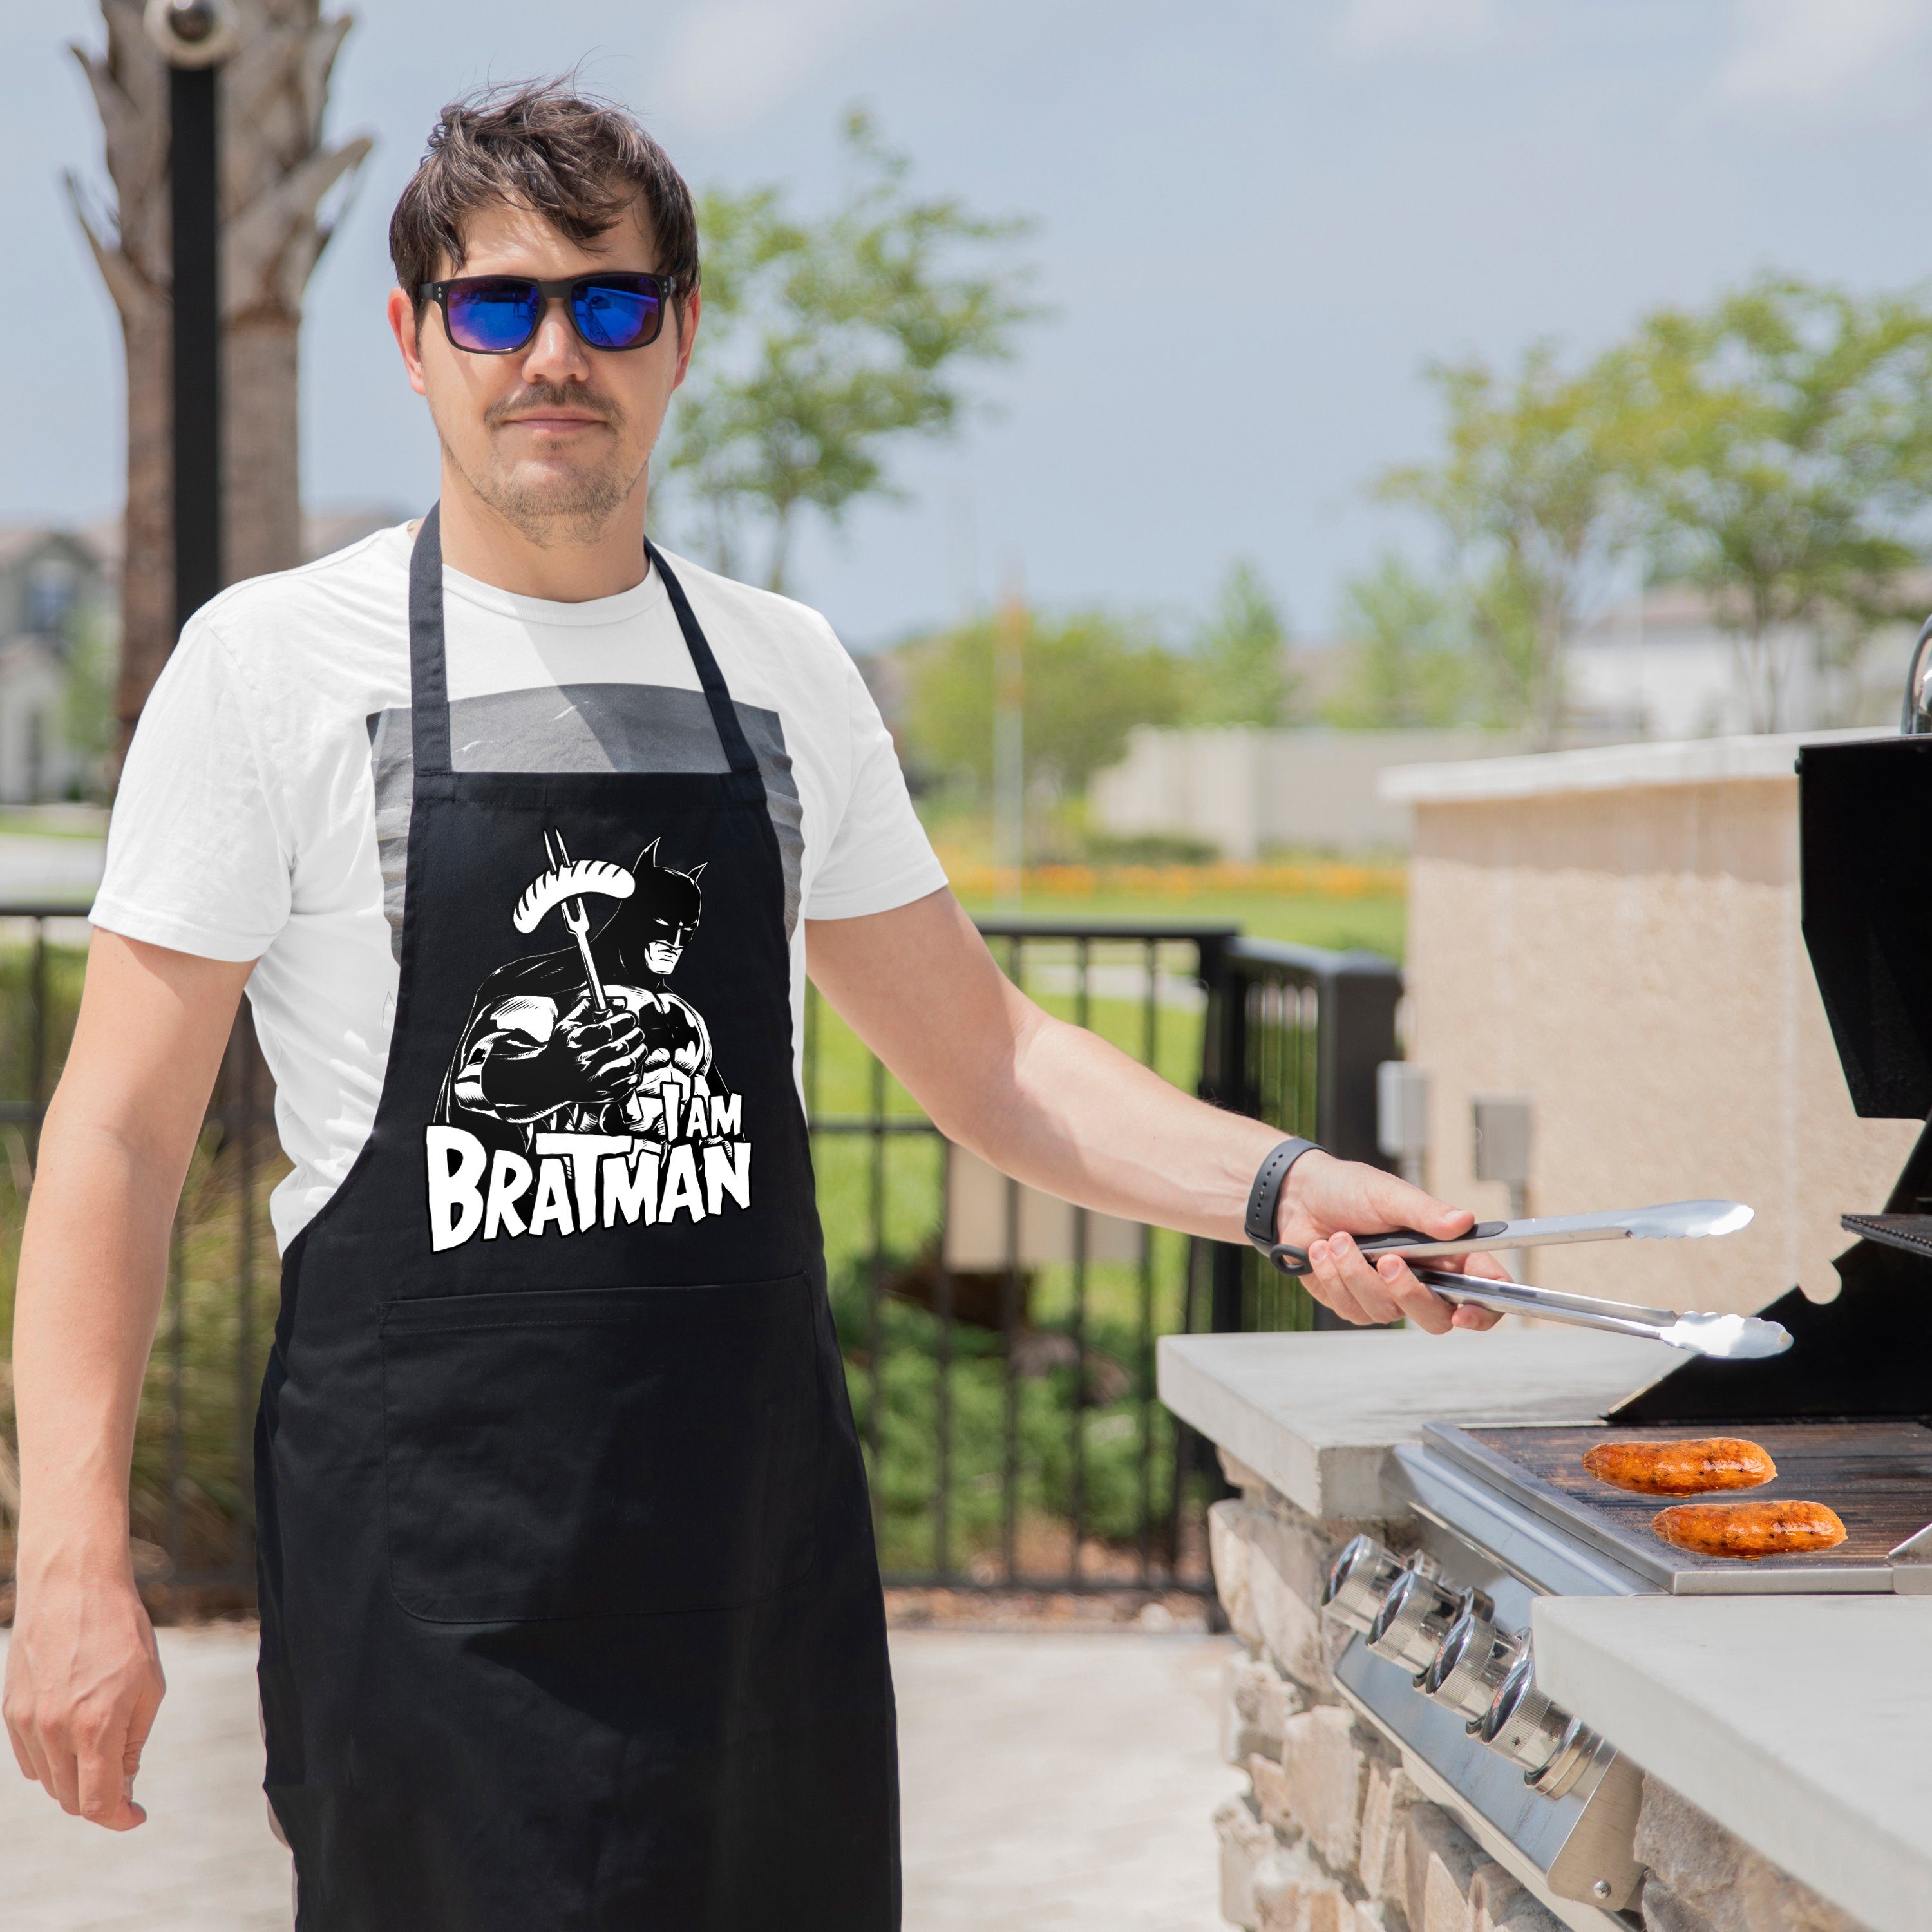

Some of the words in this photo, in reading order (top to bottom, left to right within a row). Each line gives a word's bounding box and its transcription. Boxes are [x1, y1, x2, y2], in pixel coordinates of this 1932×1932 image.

[661, 1083, 681, 1143] I
[685, 1092, 743, 1139] AM
[425, 1125, 752, 1253] BRATMAN
